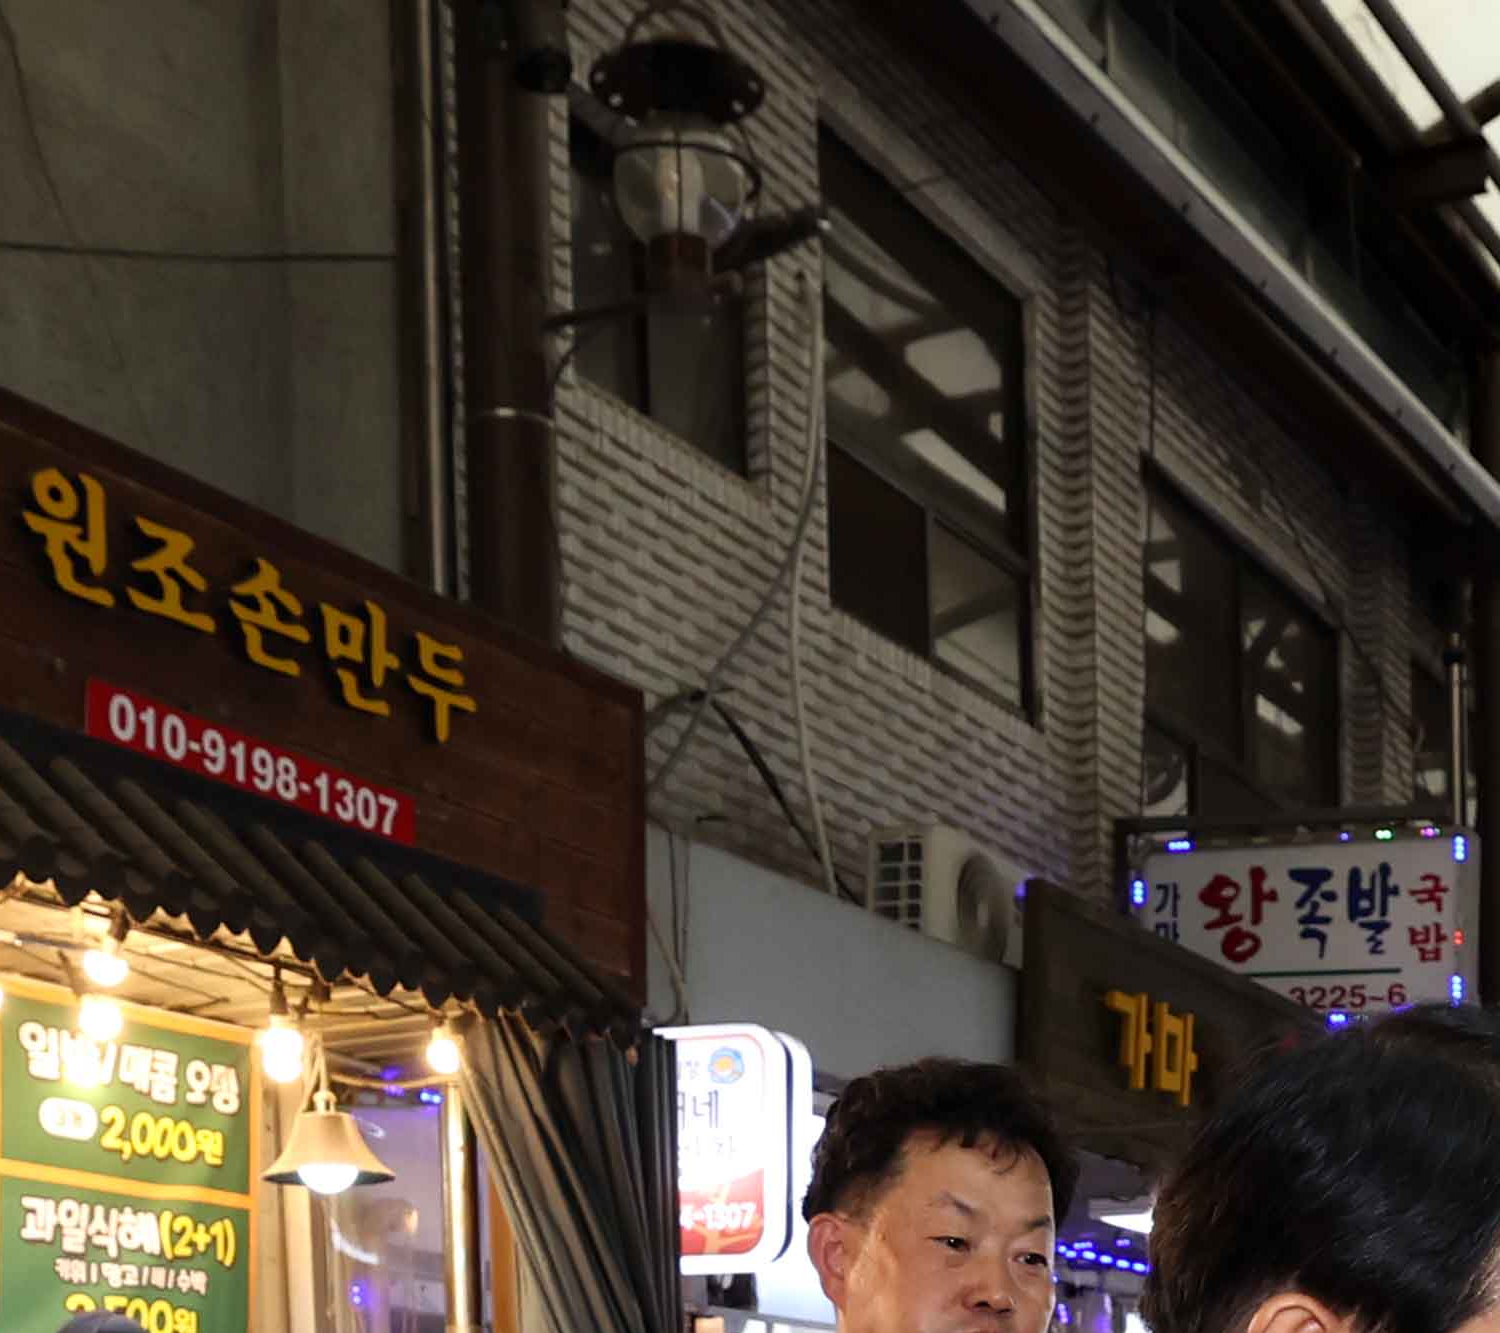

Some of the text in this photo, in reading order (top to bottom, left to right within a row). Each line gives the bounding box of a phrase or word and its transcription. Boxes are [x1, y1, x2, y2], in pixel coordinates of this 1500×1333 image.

[23, 466, 477, 743] 원조손만두
[108, 692, 399, 837] 010-9198-1307
[1408, 872, 1449, 963] 국밥
[1103, 989, 1199, 1108] 가마
[98, 1104, 226, 1168] 2,000원
